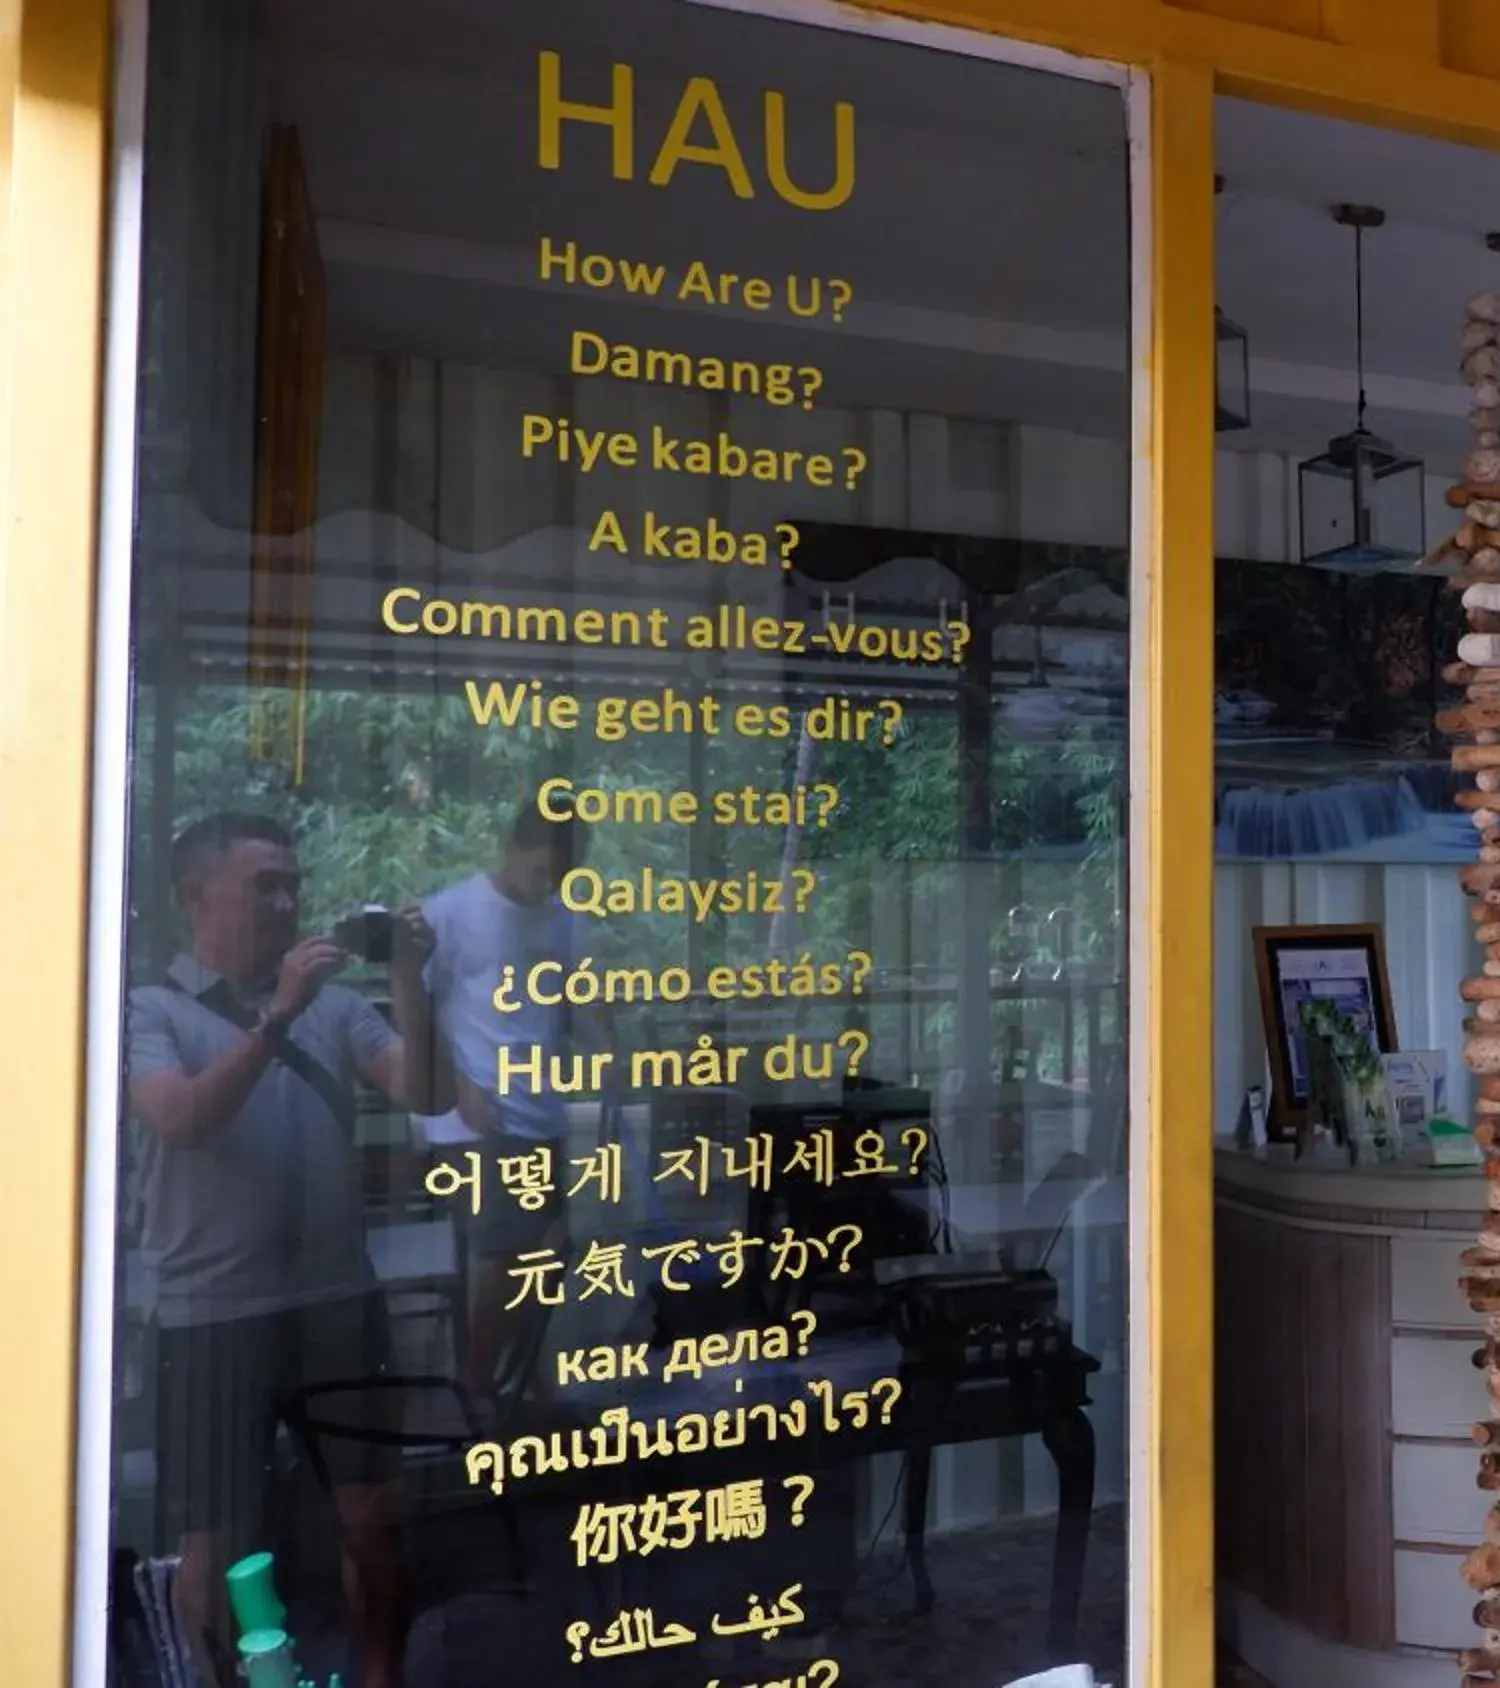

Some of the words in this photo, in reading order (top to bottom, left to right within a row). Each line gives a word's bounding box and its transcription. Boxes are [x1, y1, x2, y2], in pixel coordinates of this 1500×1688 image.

[537, 50, 856, 211] HAU
[537, 236, 666, 297] How
[676, 260, 773, 312] Are
[785, 273, 854, 322] U?
[570, 330, 824, 412] Damang?
[521, 413, 639, 474] Piye
[651, 423, 867, 491] kabare?
[587, 509, 629, 555] A
[640, 510, 800, 570] kaba?
[380, 585, 670, 650] Comment
[683, 605, 971, 664] allez-vous?
[464, 679, 580, 728] Wie
[595, 687, 720, 742] geht
[732, 707, 790, 740] es
[805, 697, 903, 746] dir?
[536, 778, 700, 825] Come
[710, 782, 840, 829] stai?
[559, 866, 818, 922] Qalaysiz?
[494, 960, 693, 1012] ¿Cómo
[706, 949, 870, 1000] estás?
[499, 1046, 612, 1094] Hur
[629, 1034, 748, 1088] mår
[762, 1028, 869, 1084] du?
[424, 1142, 622, 1215] 어떻게
[652, 1127, 928, 1198] 지내세요?
[504, 1223, 863, 1311] 元気ですか?
[556, 1343, 649, 1387] как
[662, 1310, 817, 1382] дела?
[465, 1377, 903, 1496] คุณเป็นอย่างไร?
[566, 1604, 697, 1664] حالك؟
[711, 1585, 805, 1643] كيف
